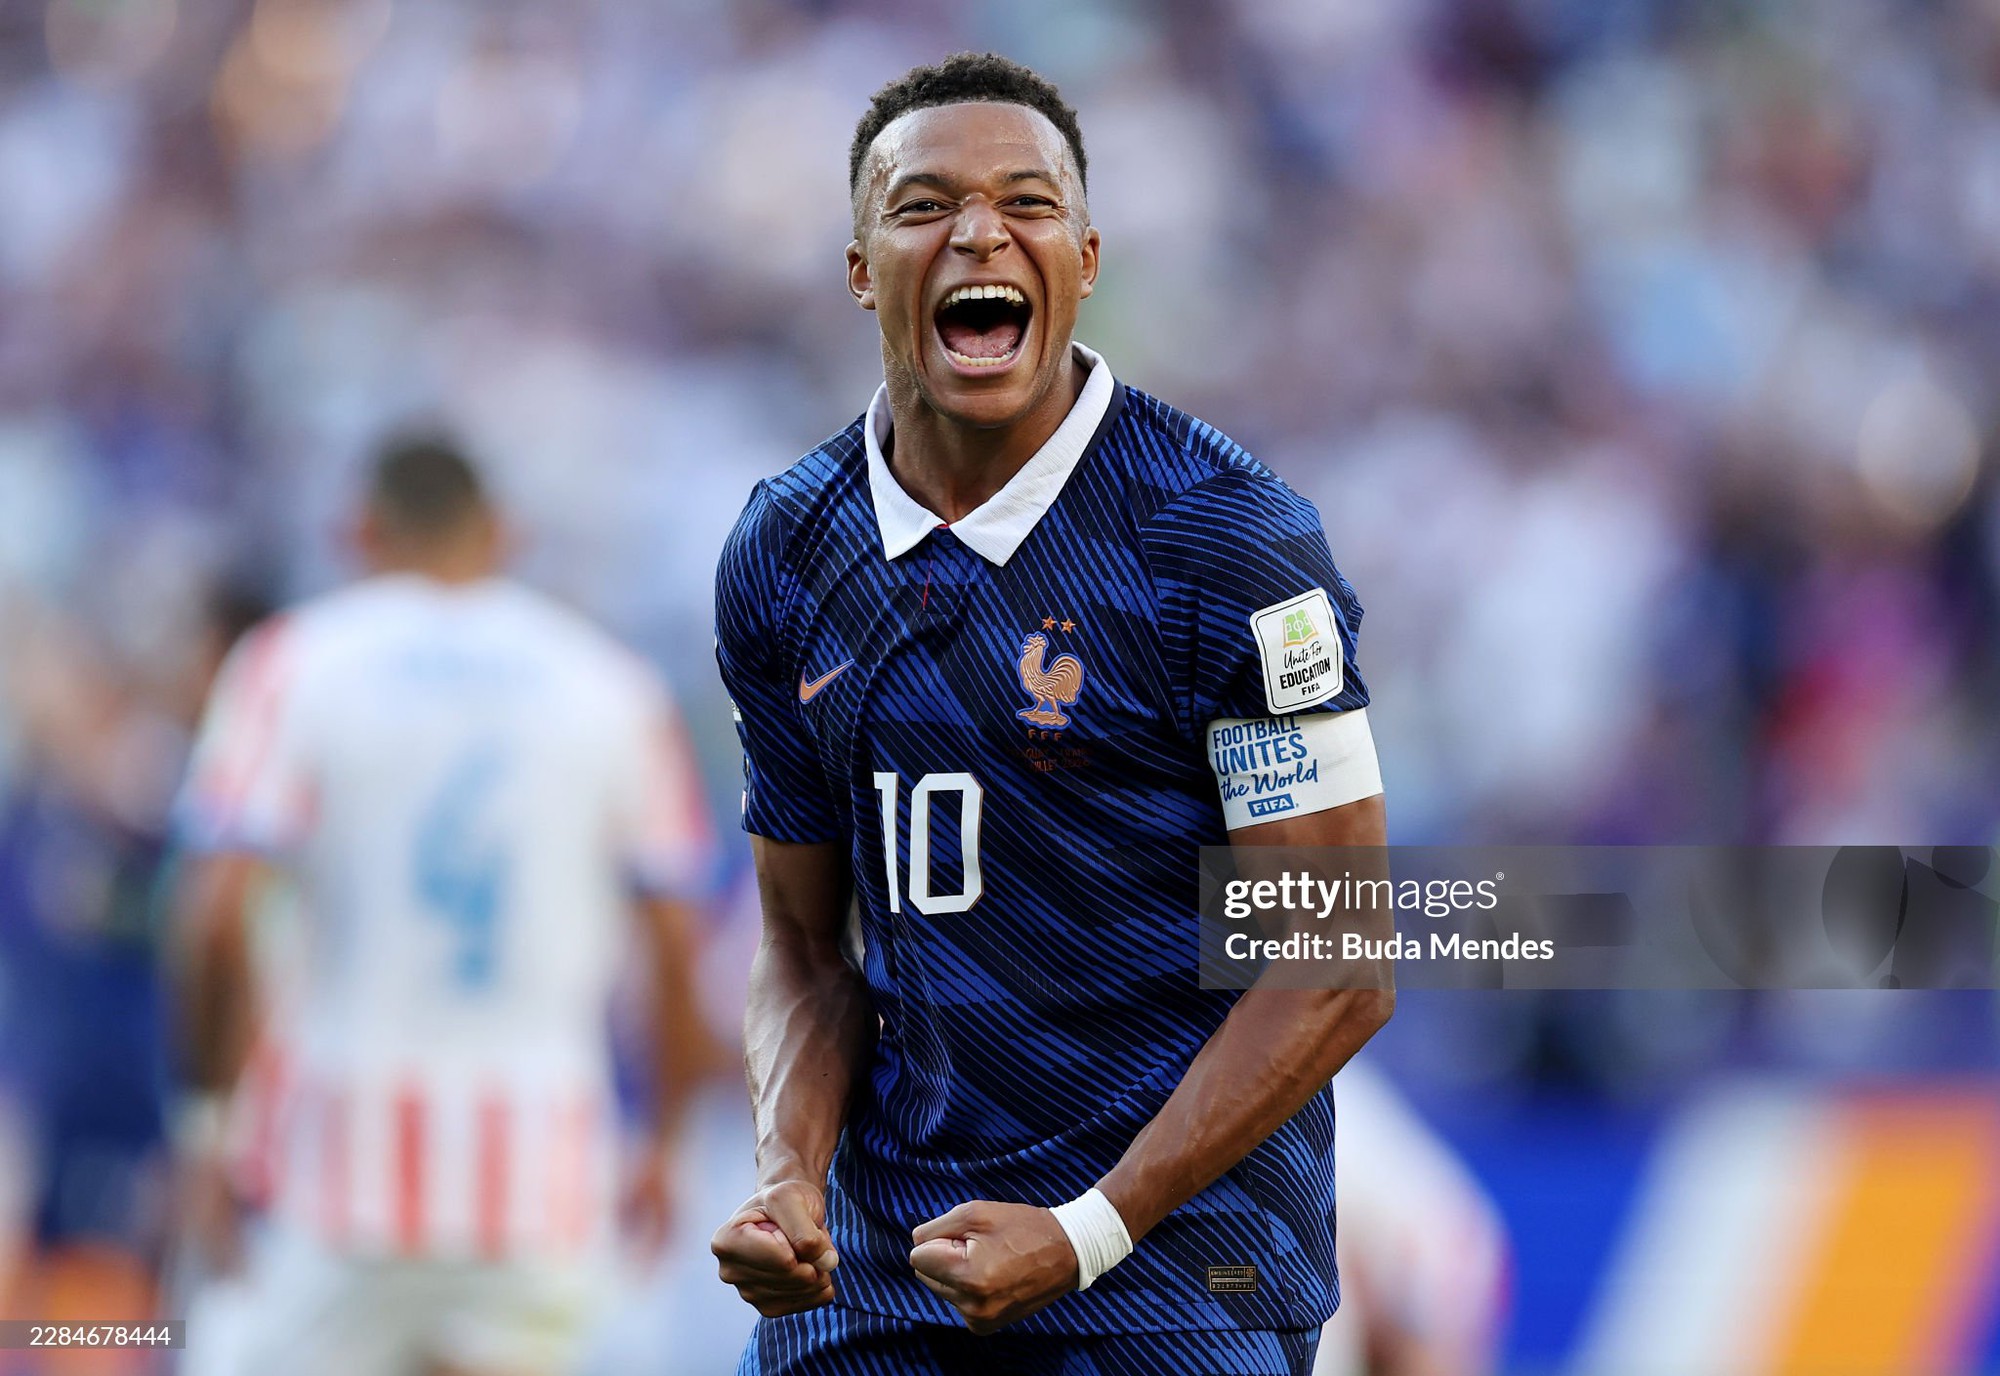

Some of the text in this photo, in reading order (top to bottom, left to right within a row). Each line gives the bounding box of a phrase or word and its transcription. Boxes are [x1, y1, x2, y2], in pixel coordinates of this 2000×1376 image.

[1279, 657, 1331, 690] EDUCATION
[1283, 650, 1310, 669] Unite
[1301, 682, 1321, 696] FIFA
[1212, 717, 1300, 748] FOOTBALL
[1215, 733, 1308, 776] UNITES
[1221, 759, 1319, 801] the World
[1251, 797, 1293, 815] FIFA
[873, 771, 984, 915] 10
